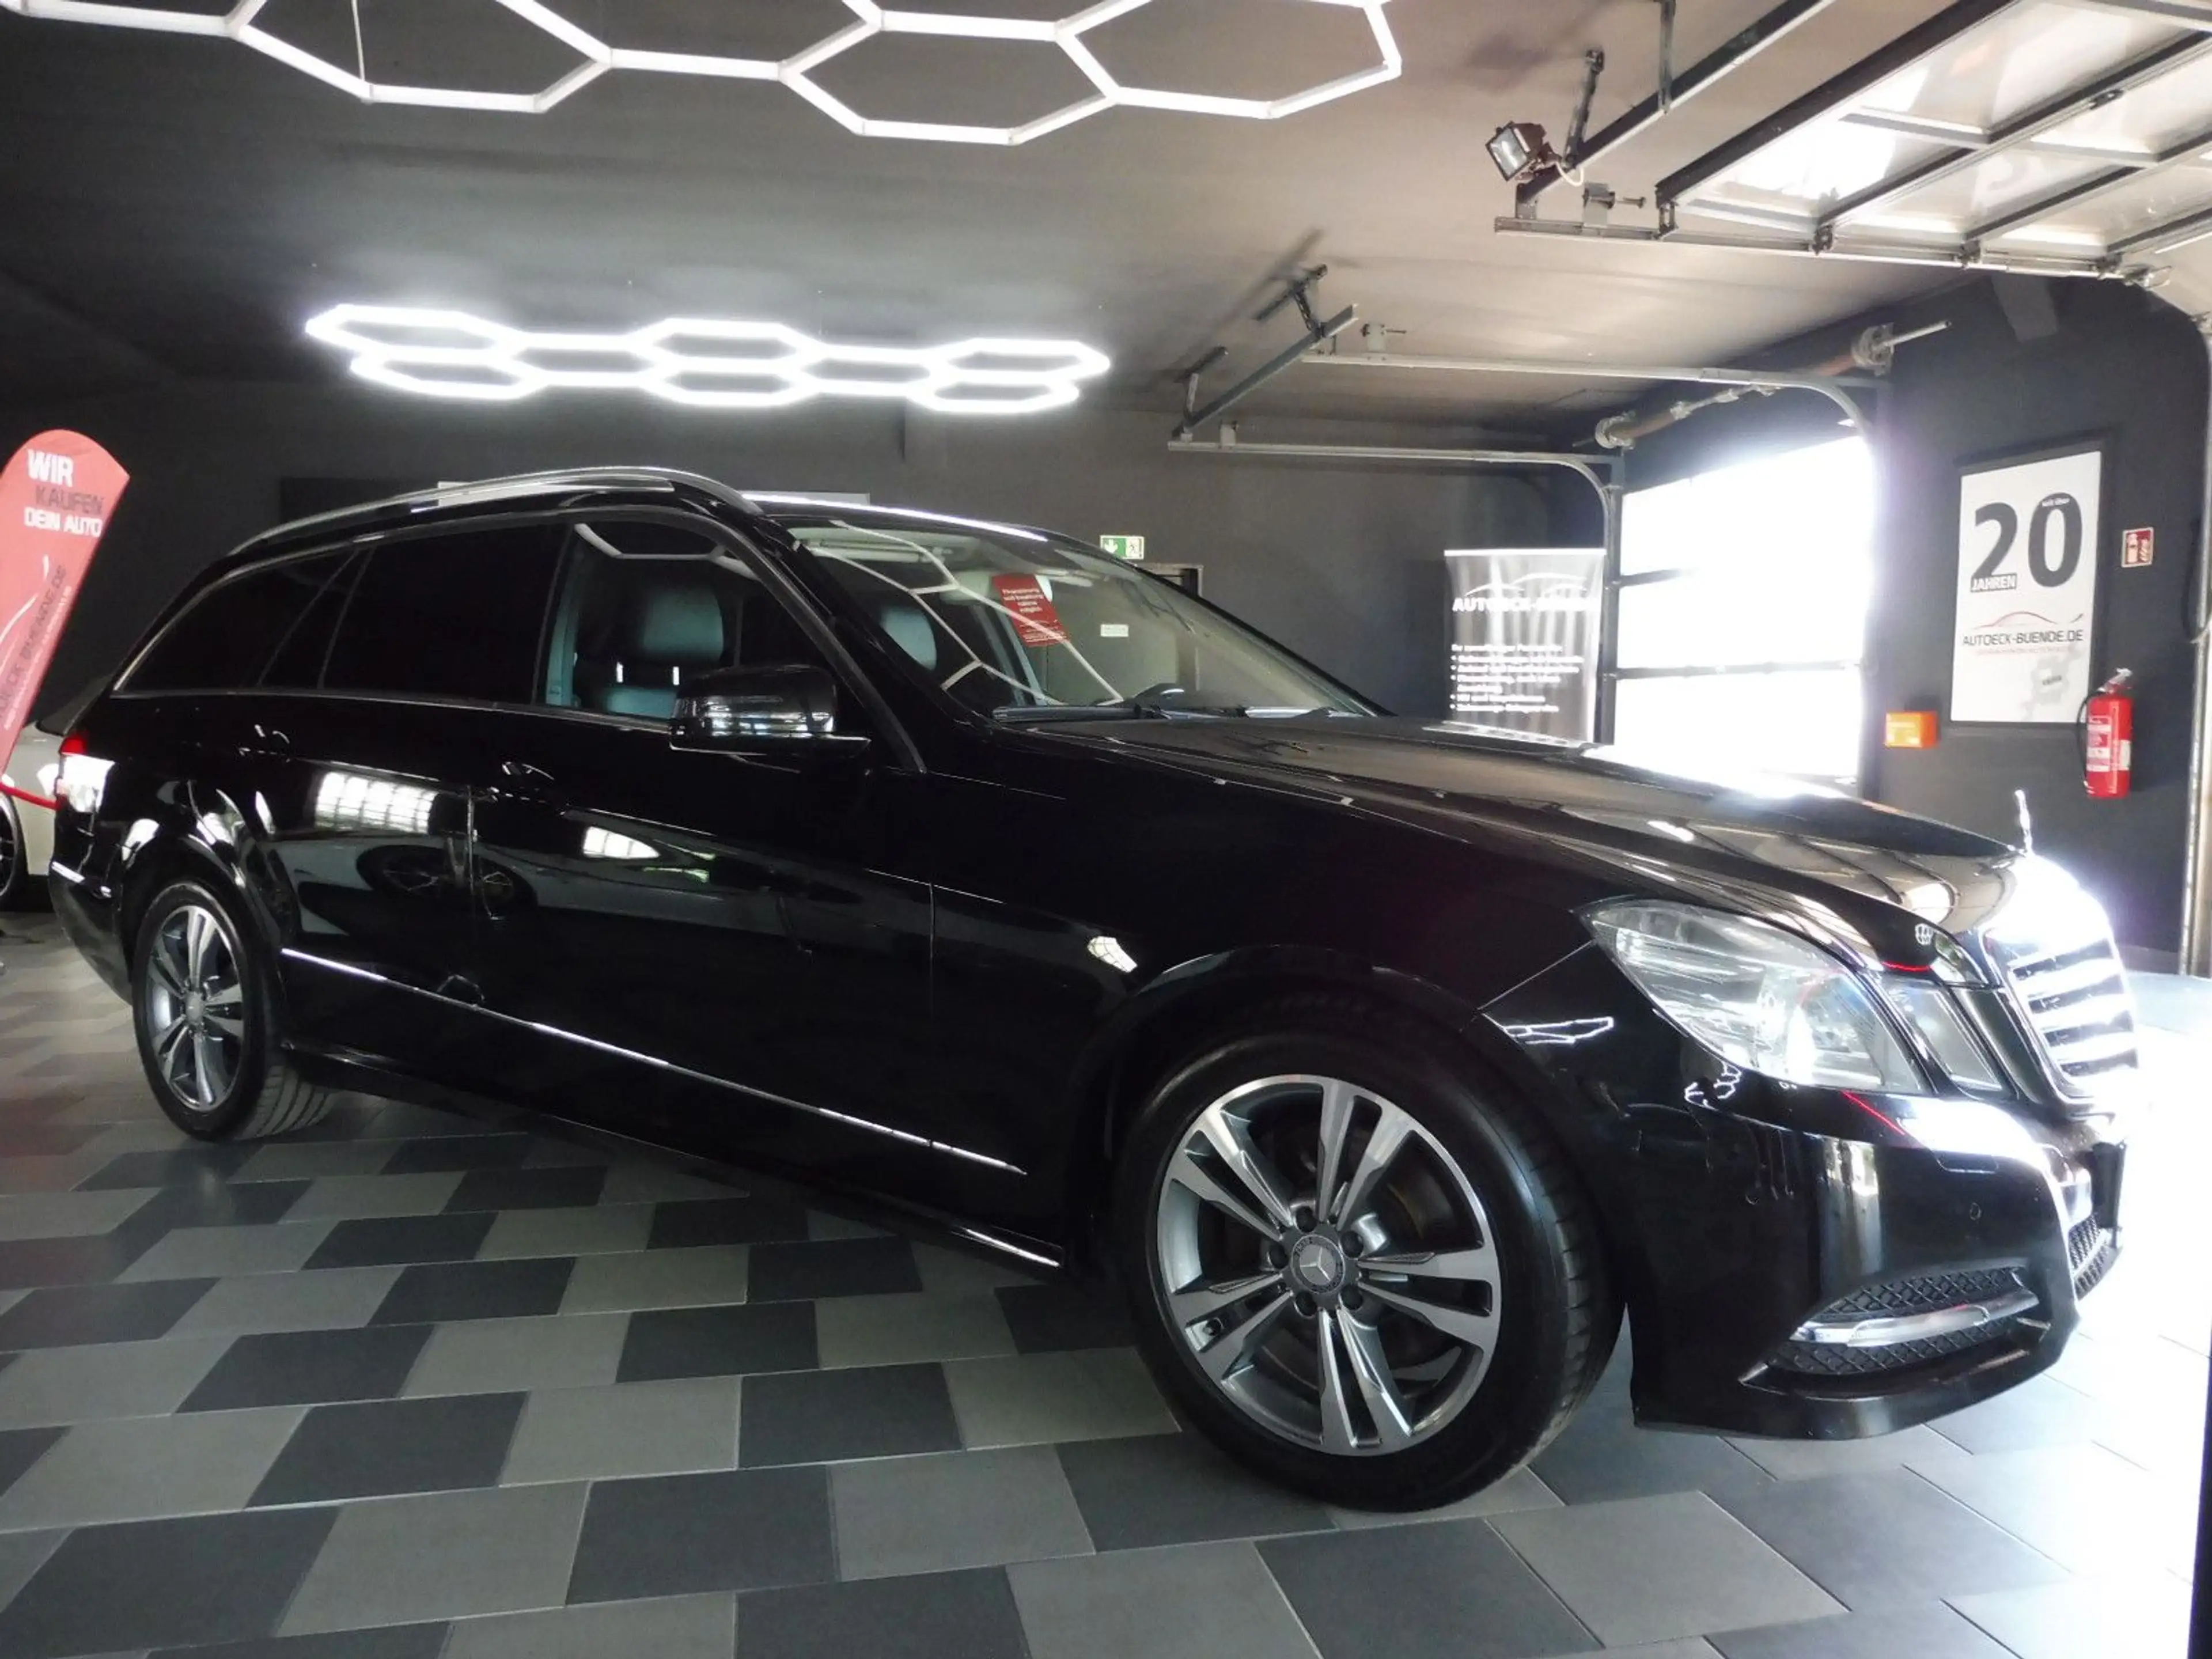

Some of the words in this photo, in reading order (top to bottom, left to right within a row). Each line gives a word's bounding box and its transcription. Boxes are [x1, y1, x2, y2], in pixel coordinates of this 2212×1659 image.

[27, 449, 74, 487] WIR
[35, 484, 104, 515] KAUFEN
[24, 506, 60, 531] DEIN
[63, 514, 103, 537] AUTO
[1971, 492, 2082, 587] 20
[1971, 575, 2016, 590] JAHREN
[1963, 629, 2084, 646] AUTOECK-BUENDE.DE
